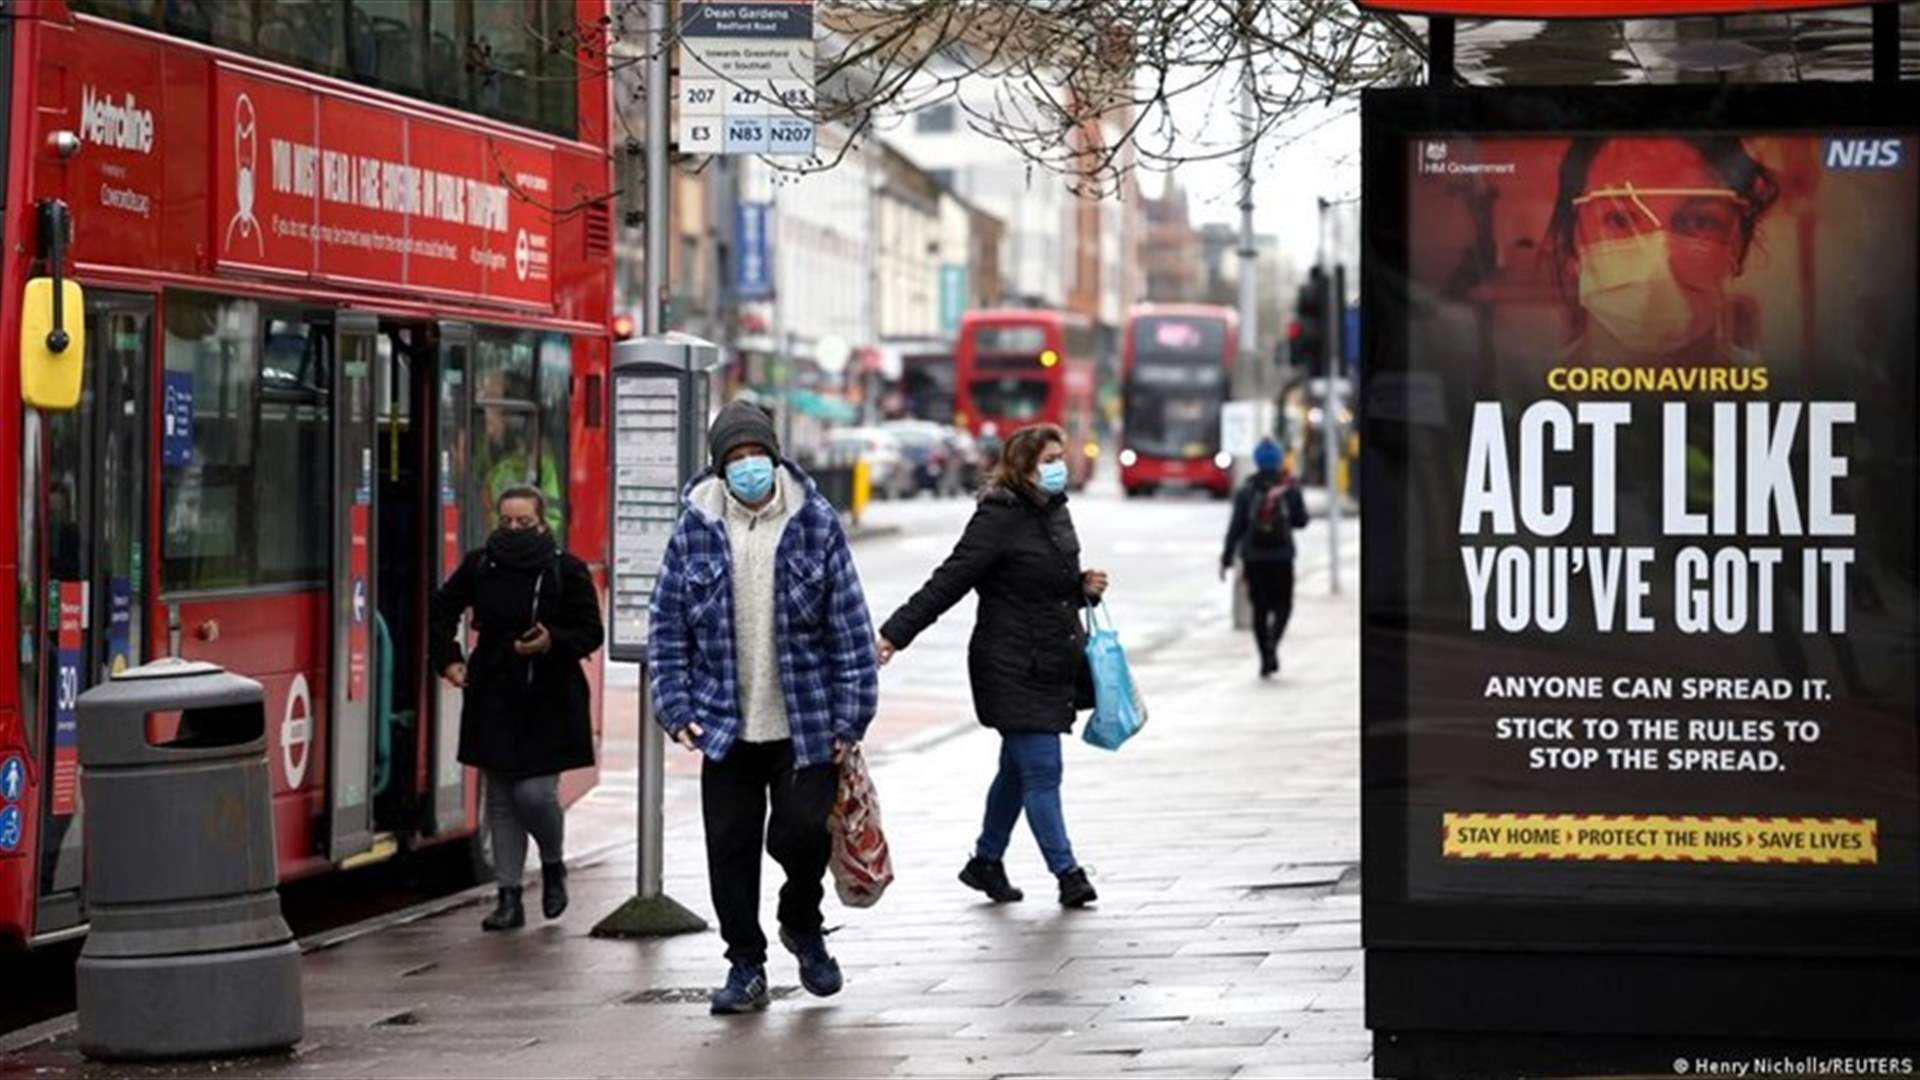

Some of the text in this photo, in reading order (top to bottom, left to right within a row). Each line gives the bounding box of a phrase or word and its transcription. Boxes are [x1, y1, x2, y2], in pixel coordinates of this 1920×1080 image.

[704, 6, 789, 20] Dean Gardens
[753, 22, 777, 31] Road
[743, 48, 790, 59] Greenford
[688, 88, 715, 104] 207
[733, 88, 761, 104] 427
[80, 83, 154, 154] Metroline
[691, 126, 711, 141] E3
[729, 127, 763, 141] N83
[771, 127, 812, 142] N207
[1827, 140, 1901, 167] NHS
[1425, 162, 1515, 174] HM Government
[1547, 366, 1769, 391] CORONAVIRUS
[1459, 401, 1856, 537] ACT LIKE
[1461, 546, 1855, 634] YOU'VE GOT IT
[59, 665, 77, 711] 30
[1484, 677, 1832, 700] ANYONE CAN SPREAD IT.
[1496, 718, 1820, 742] STICK TO THE RULES TO
[1529, 748, 1786, 771] STOP THE SPREAD.
[1457, 828, 1862, 850] STAY HOME PROTECT THE NHS SAVE LIVES
